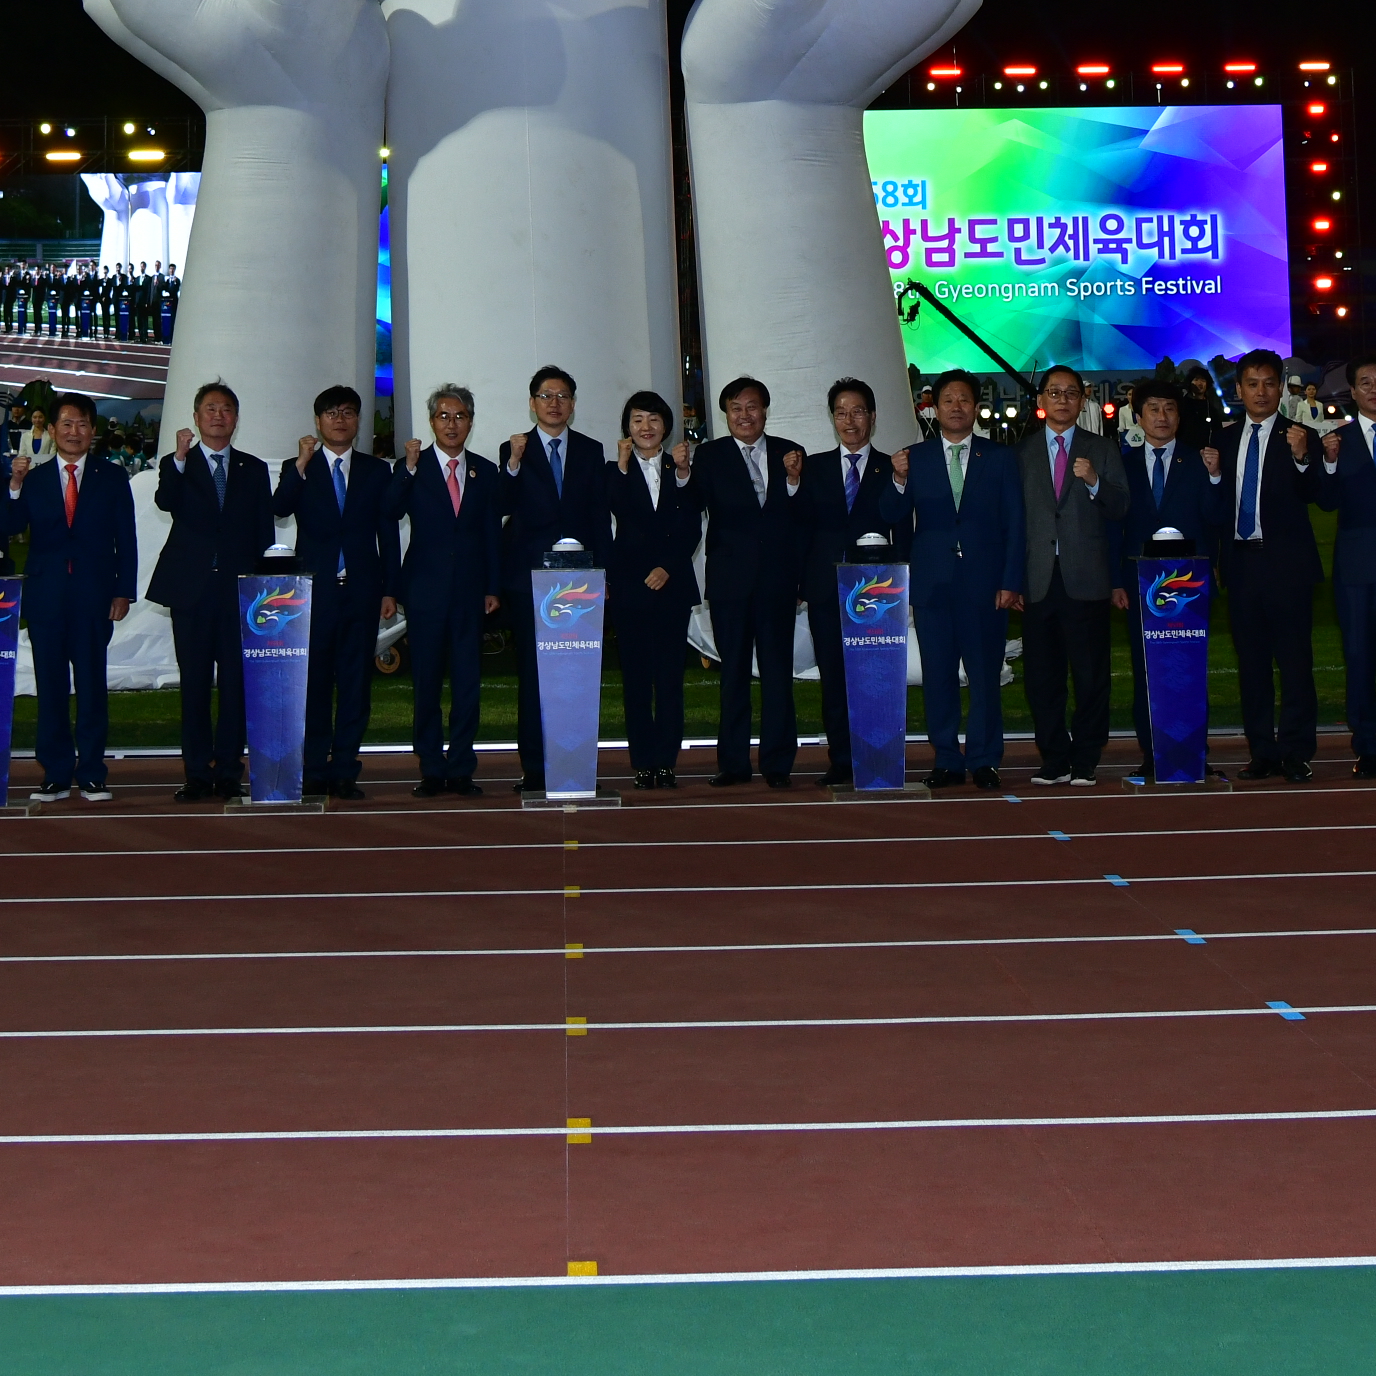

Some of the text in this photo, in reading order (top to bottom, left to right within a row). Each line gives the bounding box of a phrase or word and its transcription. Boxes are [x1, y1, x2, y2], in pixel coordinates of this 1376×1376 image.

[935, 280, 1060, 302] Gyeongnam
[1065, 278, 1135, 300] Sports
[1142, 275, 1222, 295] Festival
[1144, 629, 1206, 639] 경상남도민체육대회
[537, 640, 601, 650] 경상남도민체육대회
[843, 636, 906, 646] 경상남도민체육대회
[243, 647, 307, 657] 경상남도민체육대회
